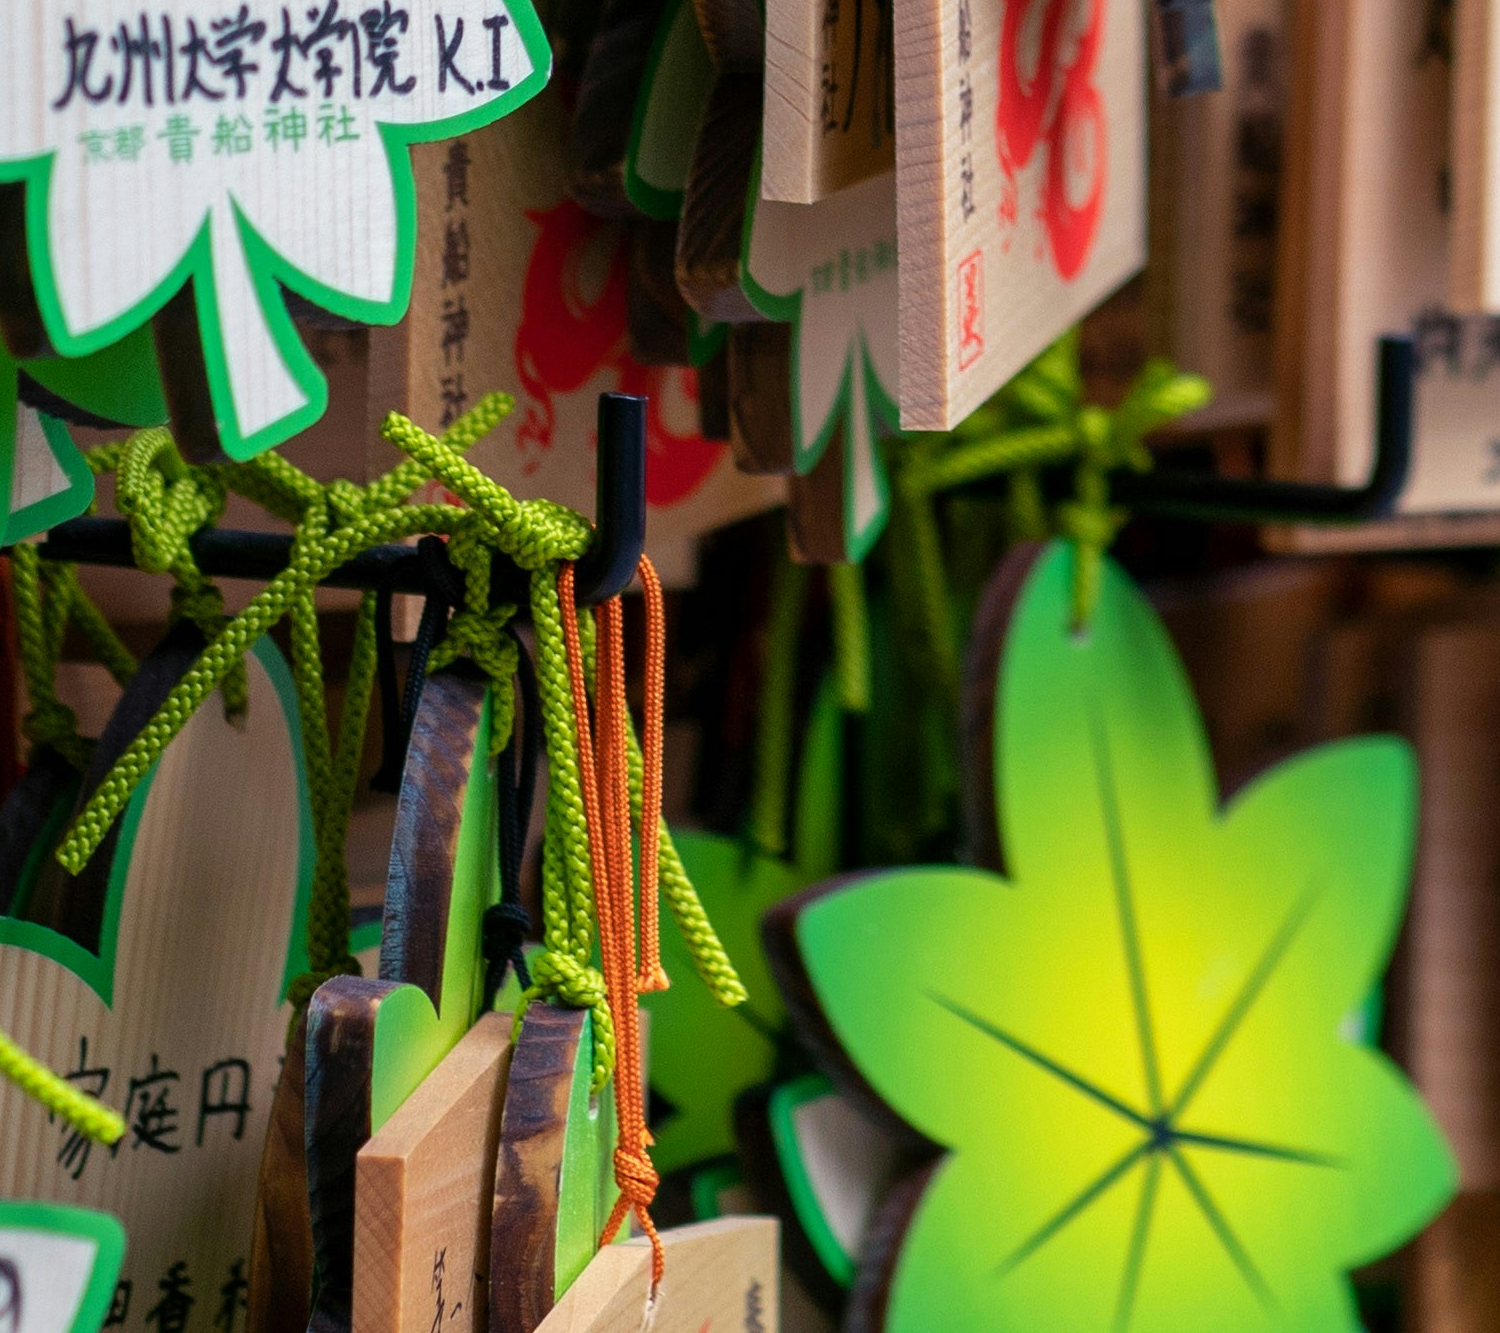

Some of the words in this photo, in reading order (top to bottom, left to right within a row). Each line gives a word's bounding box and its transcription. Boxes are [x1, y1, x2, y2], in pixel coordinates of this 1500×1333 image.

[78, 101, 364, 168] 京都貴船神社
[441, 141, 473, 430] 貴船神社
[49, 1035, 284, 1182] 家庭円
